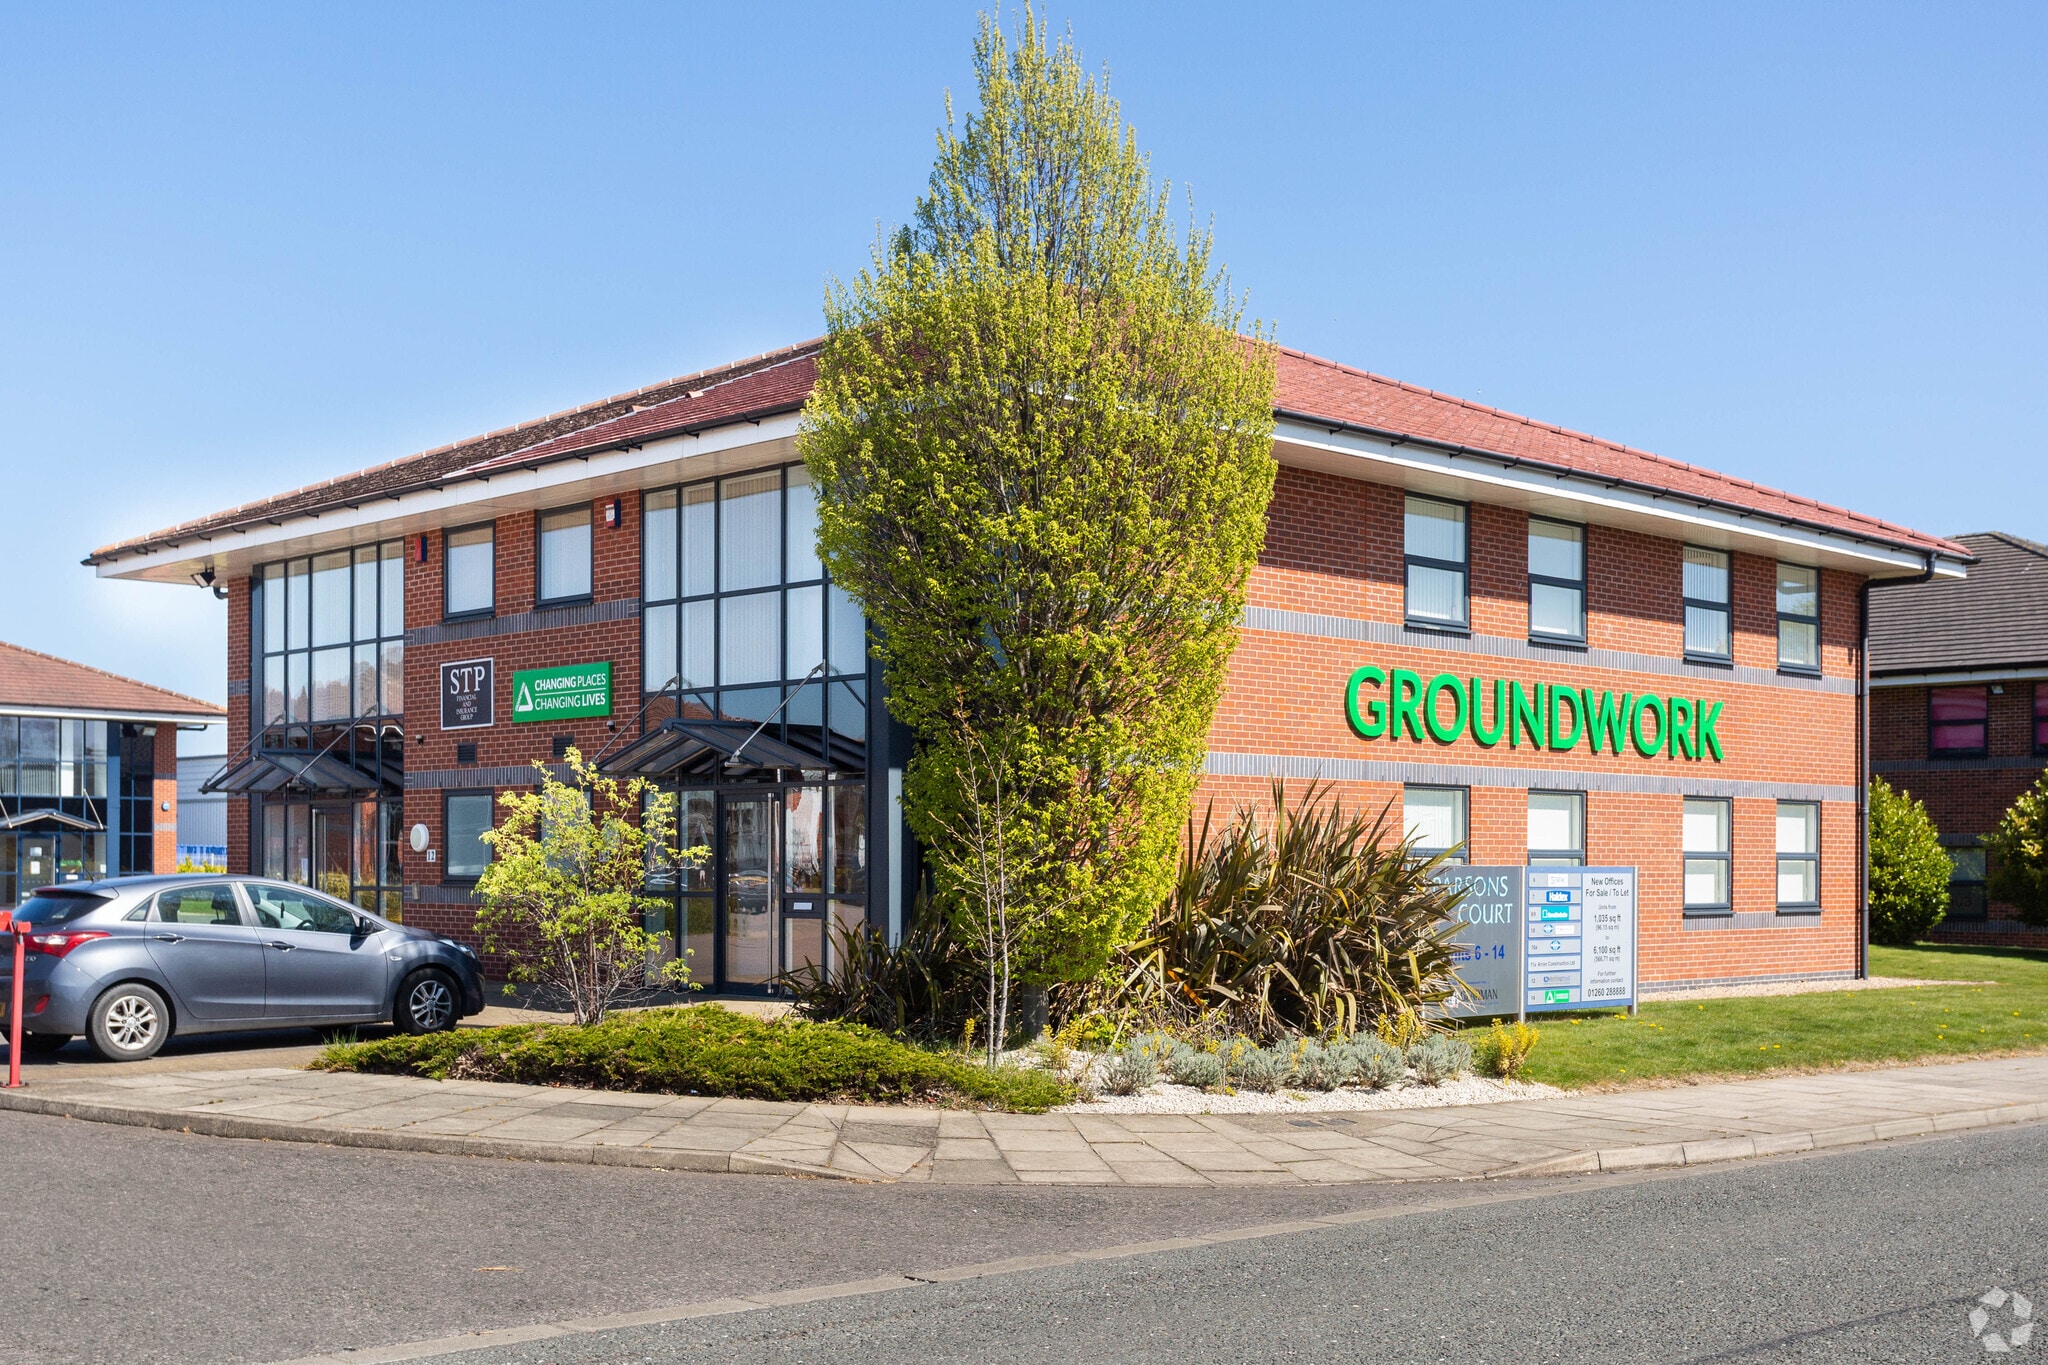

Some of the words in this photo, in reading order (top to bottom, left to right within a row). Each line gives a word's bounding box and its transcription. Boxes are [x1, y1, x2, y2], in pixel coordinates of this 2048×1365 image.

[450, 666, 485, 695] STP
[534, 676, 576, 692] CHANGING
[578, 674, 606, 688] PLACES
[456, 694, 477, 702] FINANCIAL
[534, 694, 580, 711] CHANGING
[582, 692, 606, 706] LIVES
[456, 706, 478, 715] INSURANCE
[1344, 665, 1724, 762] GROUNDWORK
[428, 851, 434, 860] 12
[1432, 876, 1509, 897] PARSONS
[1592, 877, 1603, 886] New
[1604, 877, 1624, 886] Offices
[1597, 889, 1608, 897] Sale
[1458, 903, 1513, 924] COURT
[1475, 945, 1481, 960] 6
[1492, 945, 1505, 960] 14
[1593, 946, 1608, 955] 6,100
[1617, 945, 1621, 953] ft
